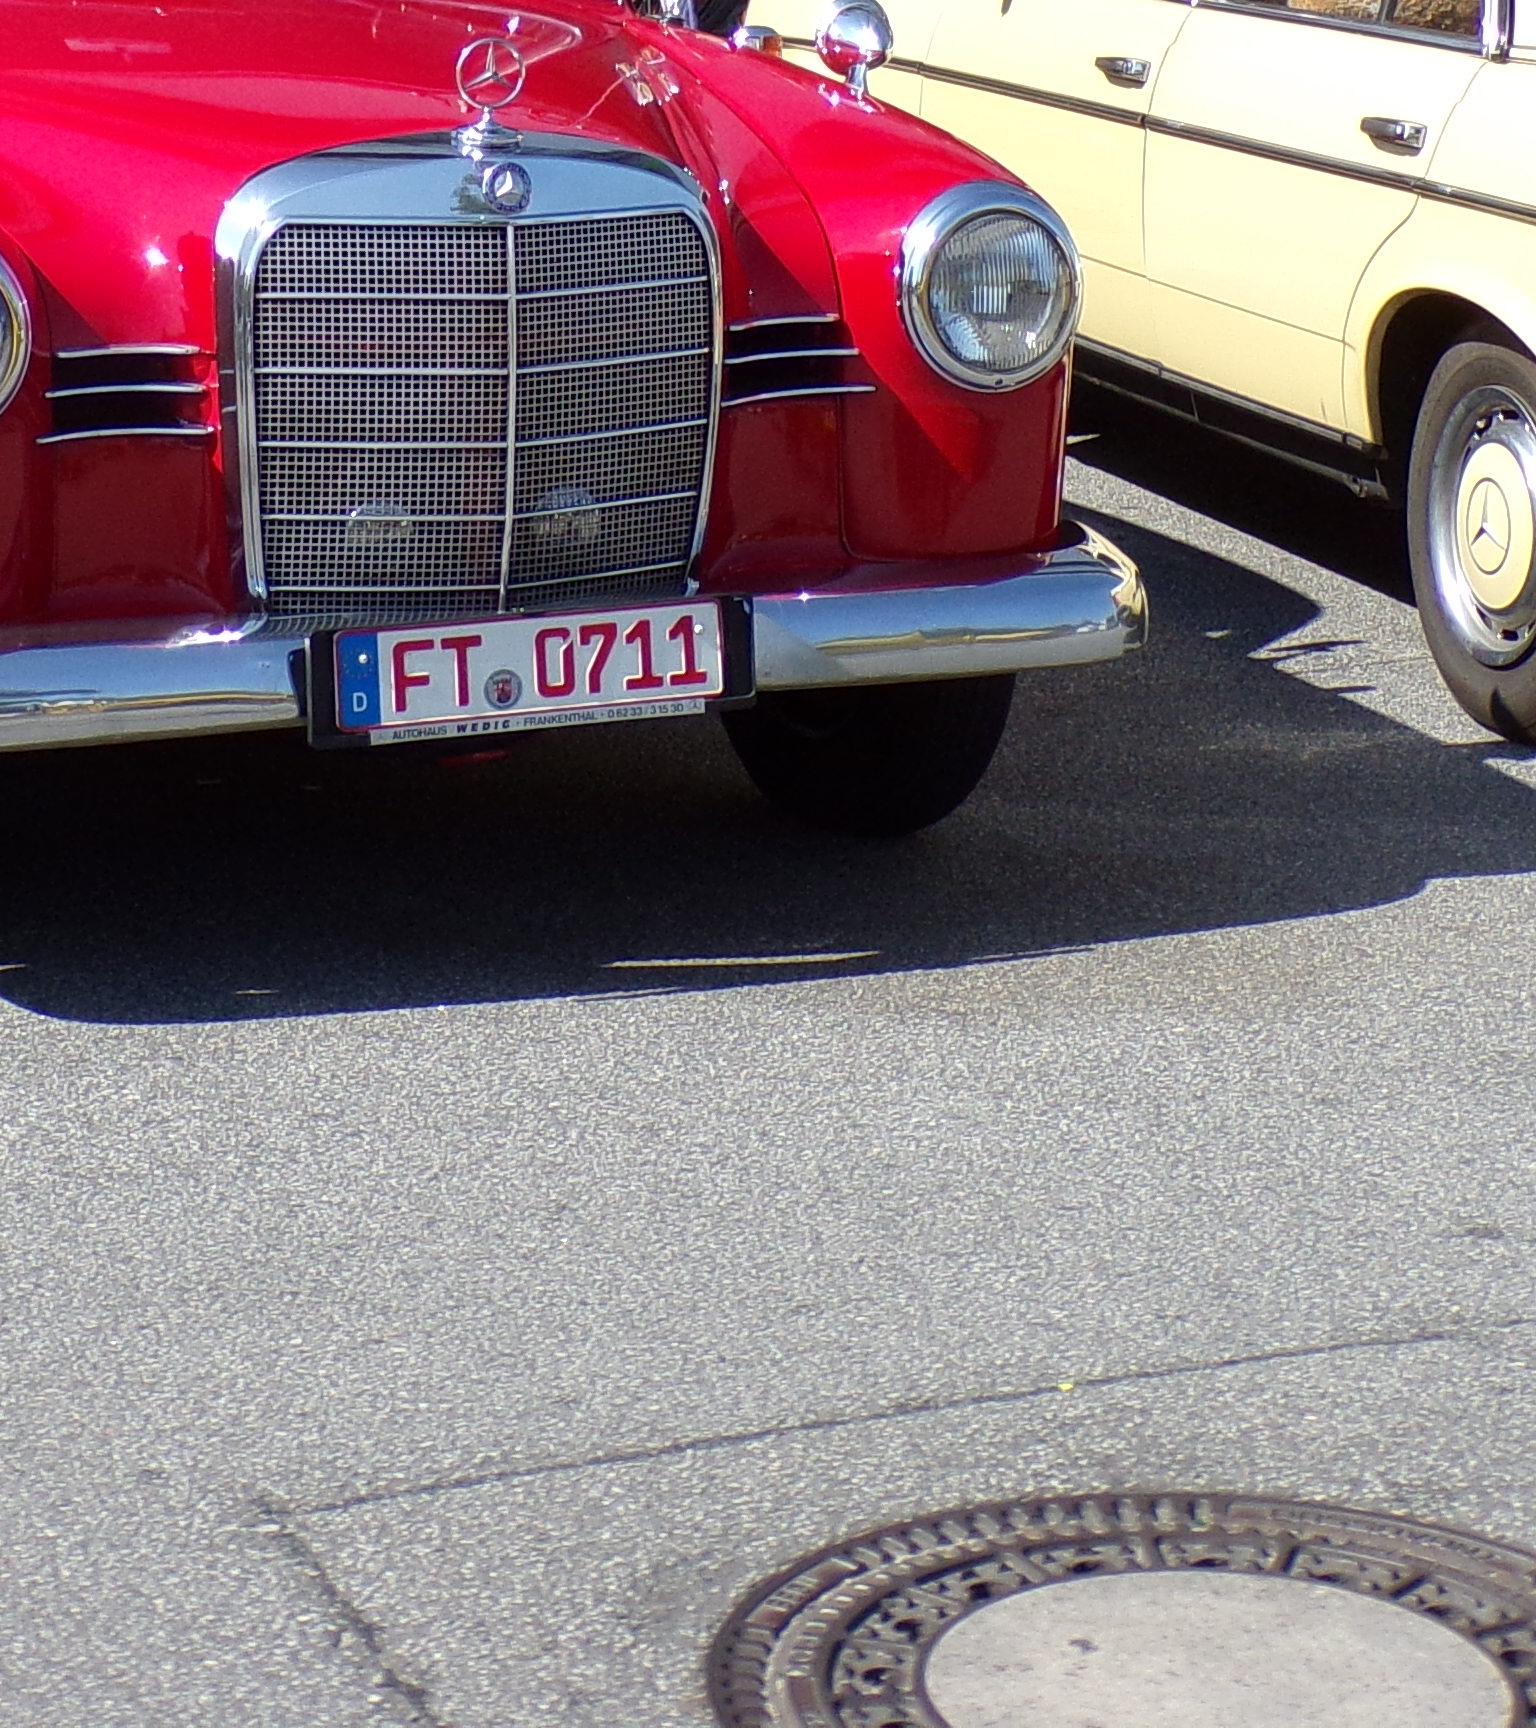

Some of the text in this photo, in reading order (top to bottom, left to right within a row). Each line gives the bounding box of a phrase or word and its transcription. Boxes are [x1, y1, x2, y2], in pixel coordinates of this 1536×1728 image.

[392, 614, 708, 713] FT 0711
[352, 692, 368, 713] D
[392, 725, 448, 741] AUTOHAUS
[523, 710, 598, 728] FRANKENTHAL
